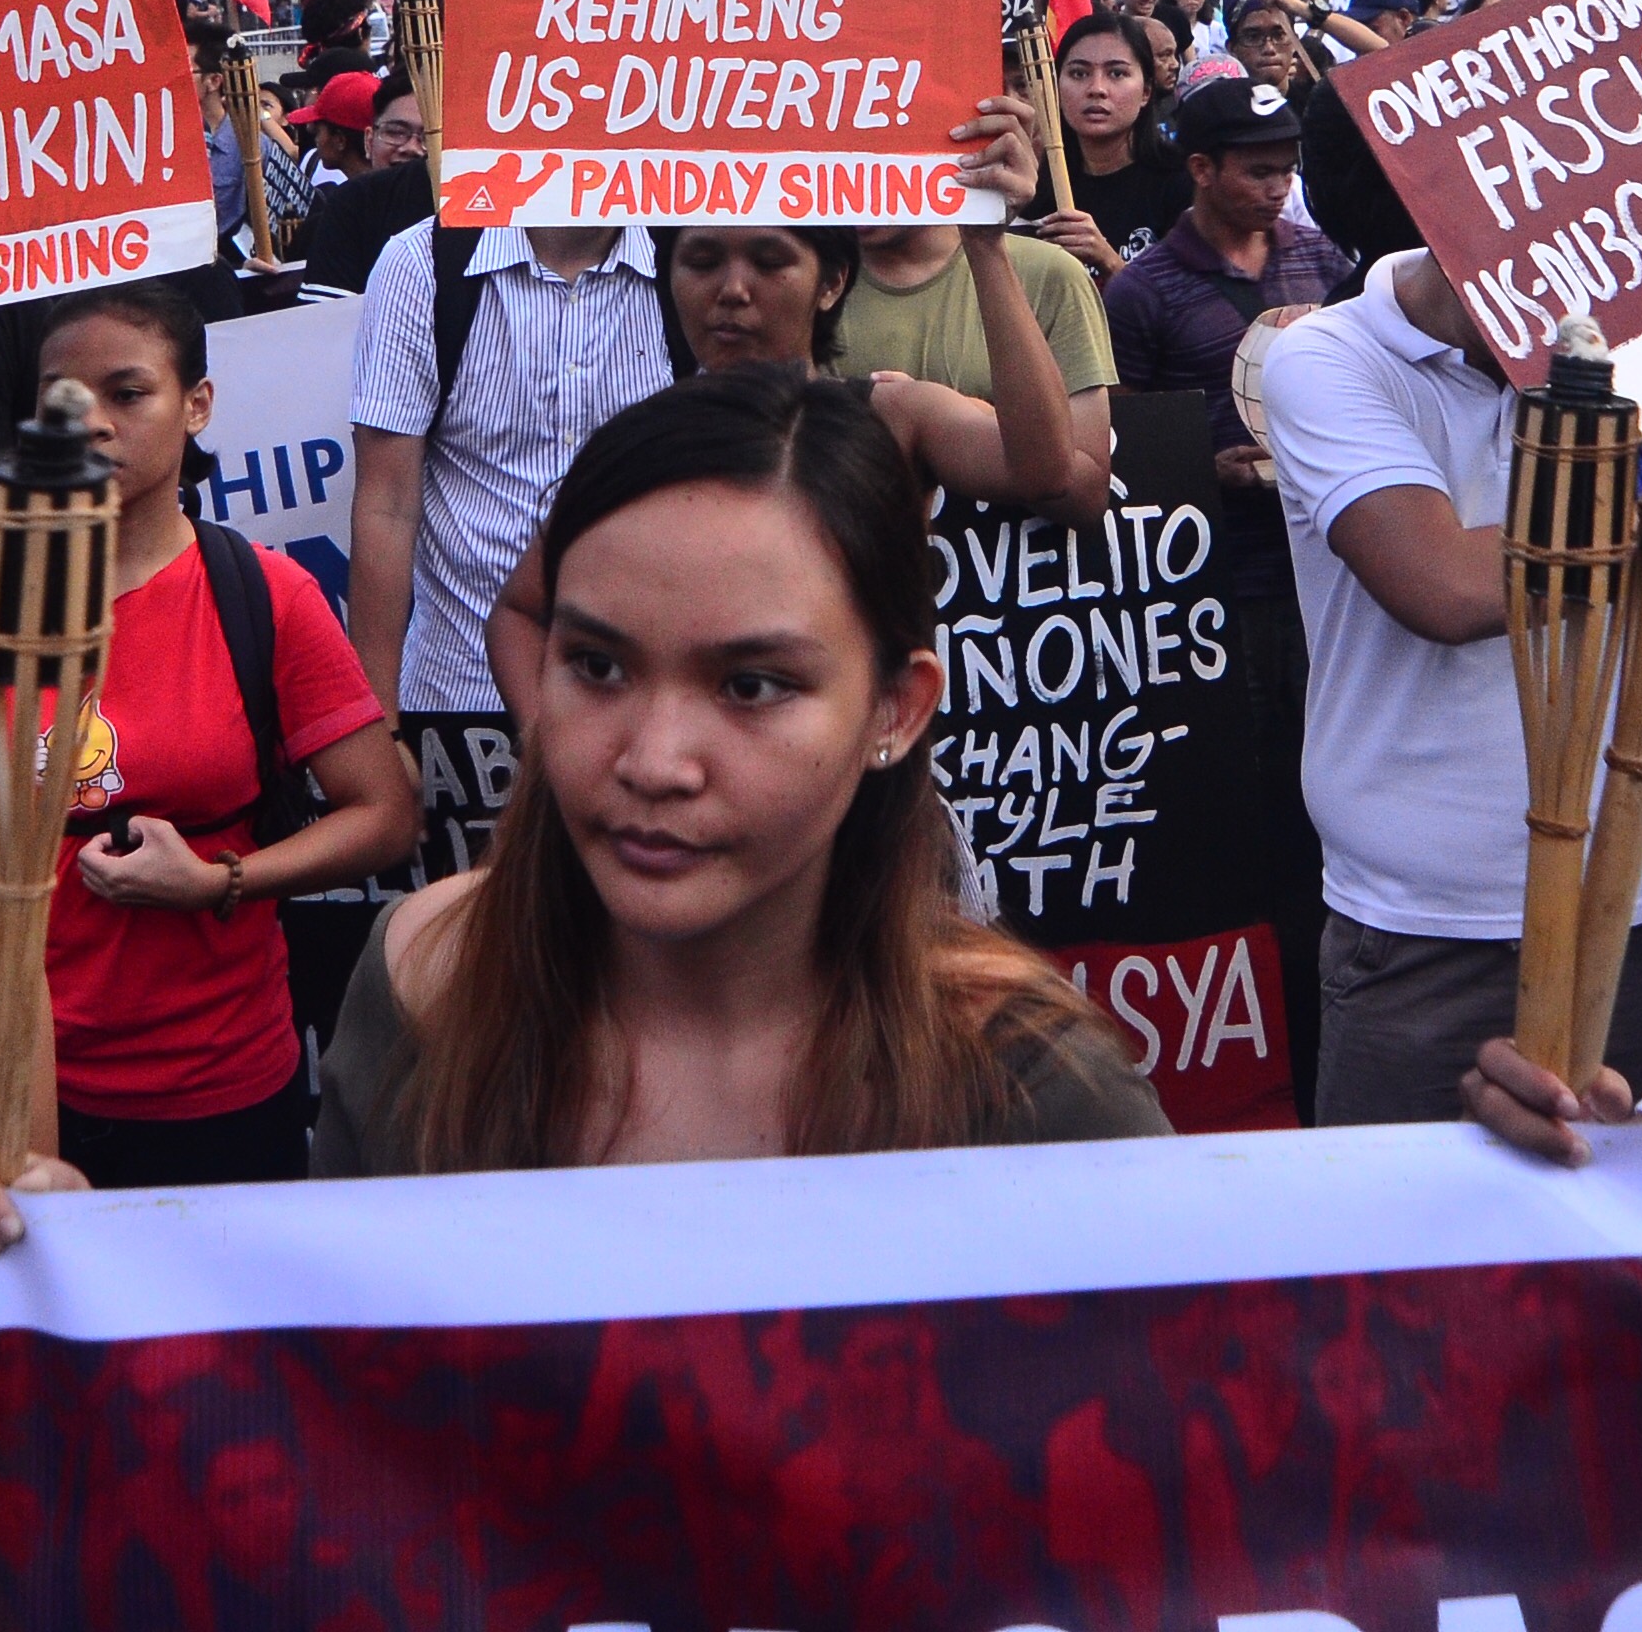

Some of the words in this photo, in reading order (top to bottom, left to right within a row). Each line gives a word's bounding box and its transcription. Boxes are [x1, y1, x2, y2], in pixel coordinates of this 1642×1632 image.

[485, 50, 922, 134] US-DUTERTE!
[569, 159, 770, 219] PANDAY
[777, 161, 967, 218] SINING
